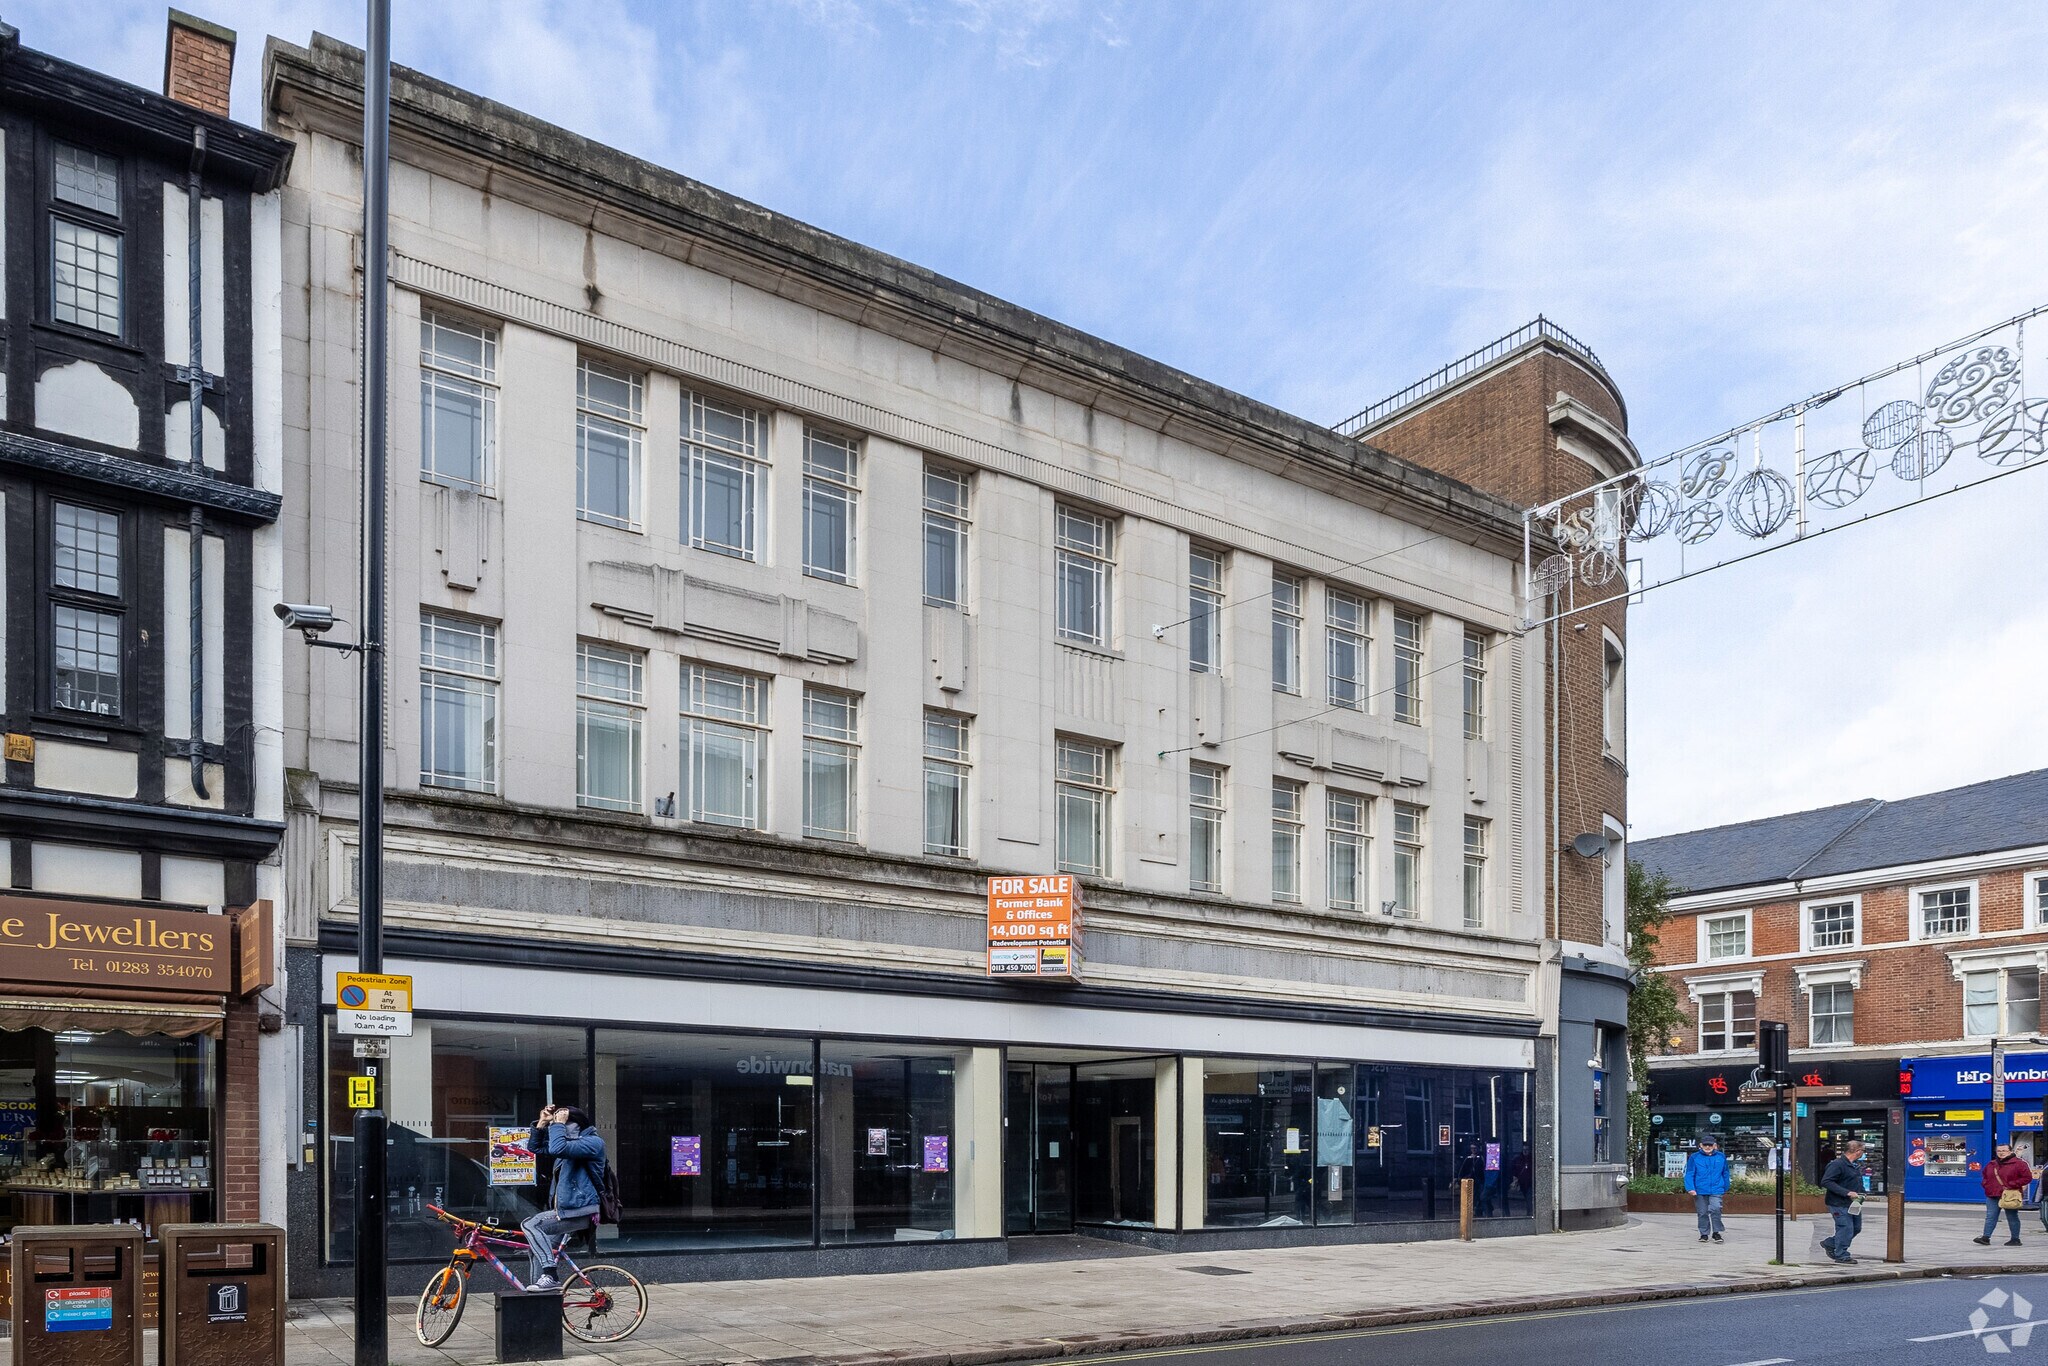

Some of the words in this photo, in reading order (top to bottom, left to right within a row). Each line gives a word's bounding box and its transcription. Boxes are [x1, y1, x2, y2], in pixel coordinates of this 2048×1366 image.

[992, 879, 1024, 894] FOR
[1029, 878, 1068, 894] SALE
[996, 900, 1034, 908] Former
[1036, 898, 1063, 907] Bank
[1006, 911, 1014, 920] &
[1017, 910, 1052, 919] Offices
[0, 918, 24, 938] e
[37, 913, 214, 951] Jewellers
[991, 924, 1036, 937] 14,000
[1040, 926, 1054, 937] sq
[1058, 924, 1068, 934] ft
[68, 958, 98, 972] Tel.
[106, 961, 150, 974] 01283
[157, 964, 212, 978] 354070
[370, 1014, 396, 1022] loading
